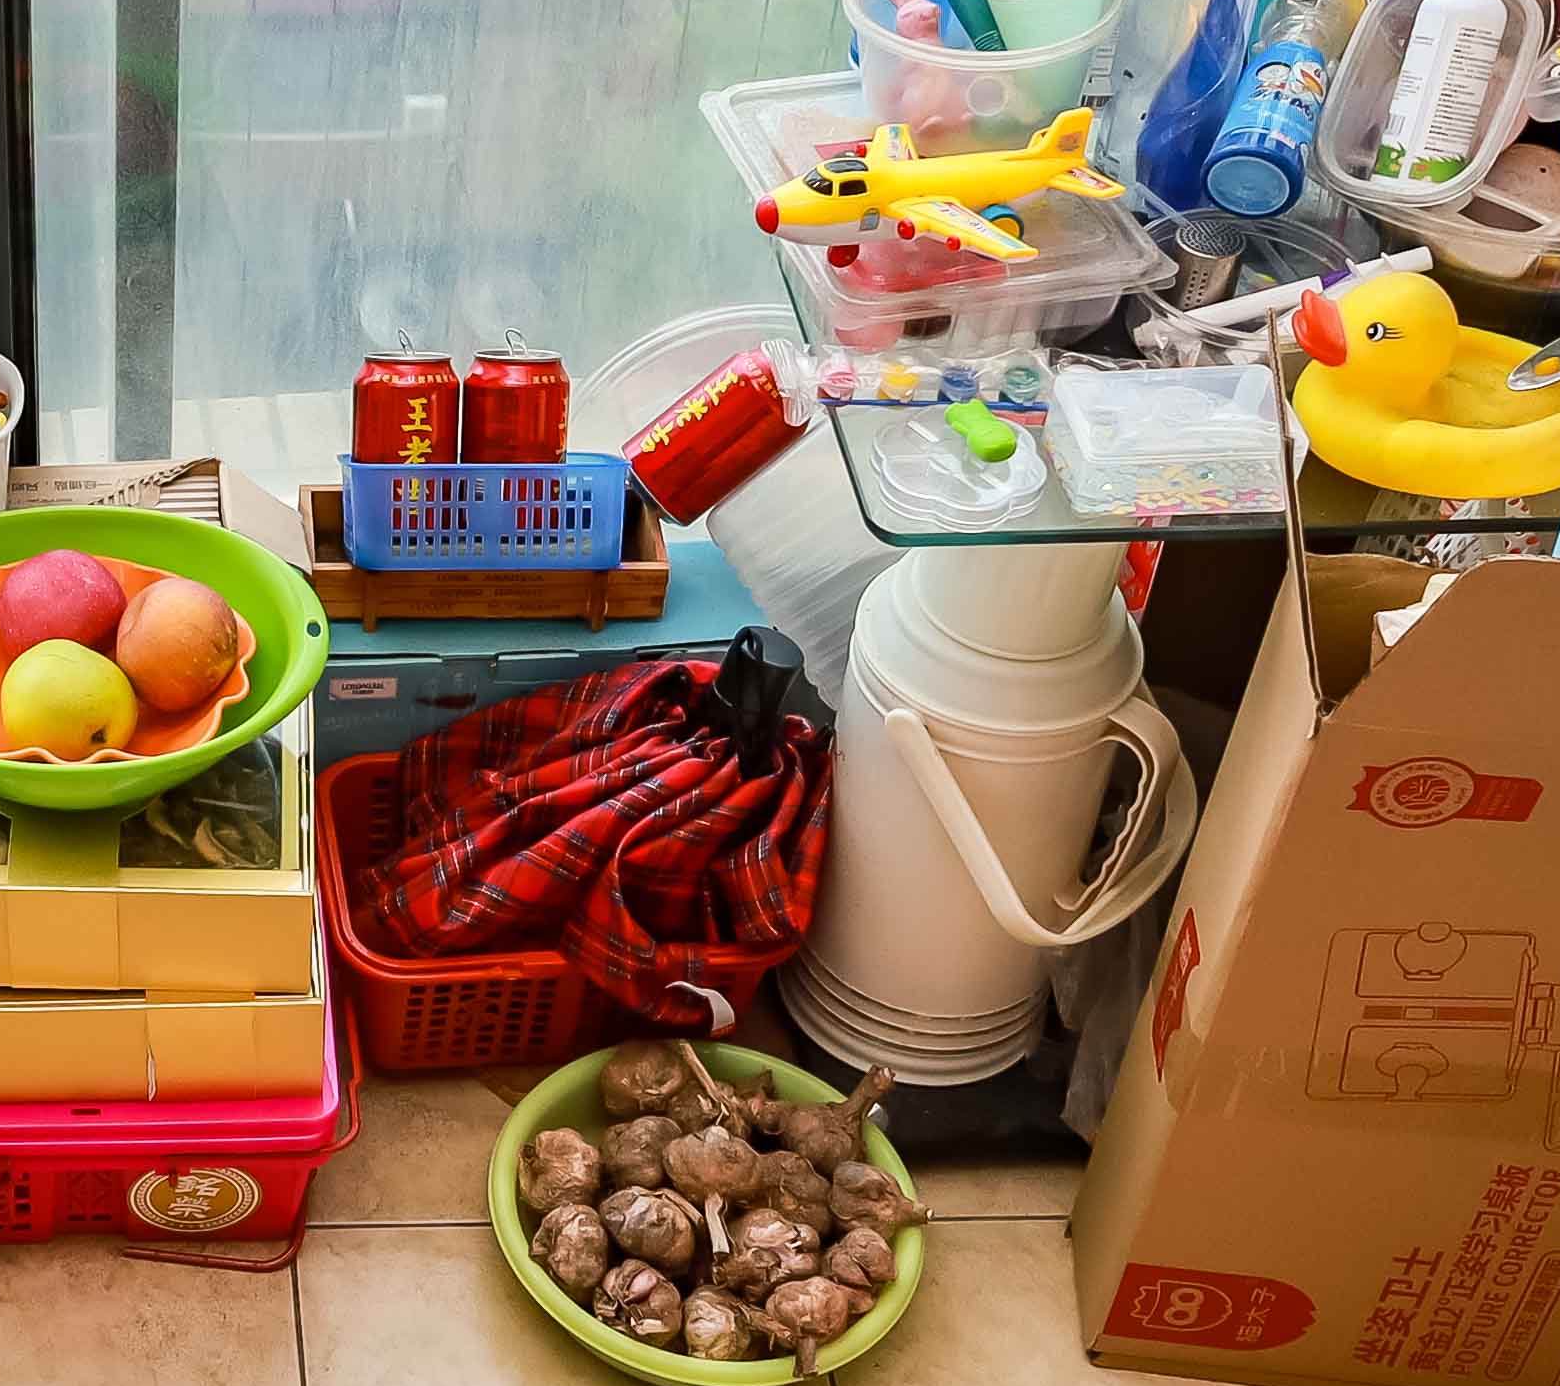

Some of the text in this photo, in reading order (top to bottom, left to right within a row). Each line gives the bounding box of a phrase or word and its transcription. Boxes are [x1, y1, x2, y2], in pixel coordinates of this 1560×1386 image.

[1352, 1246, 1445, 1369] 坐姿卫士
[1448, 1291, 1510, 1379] POSTURE
